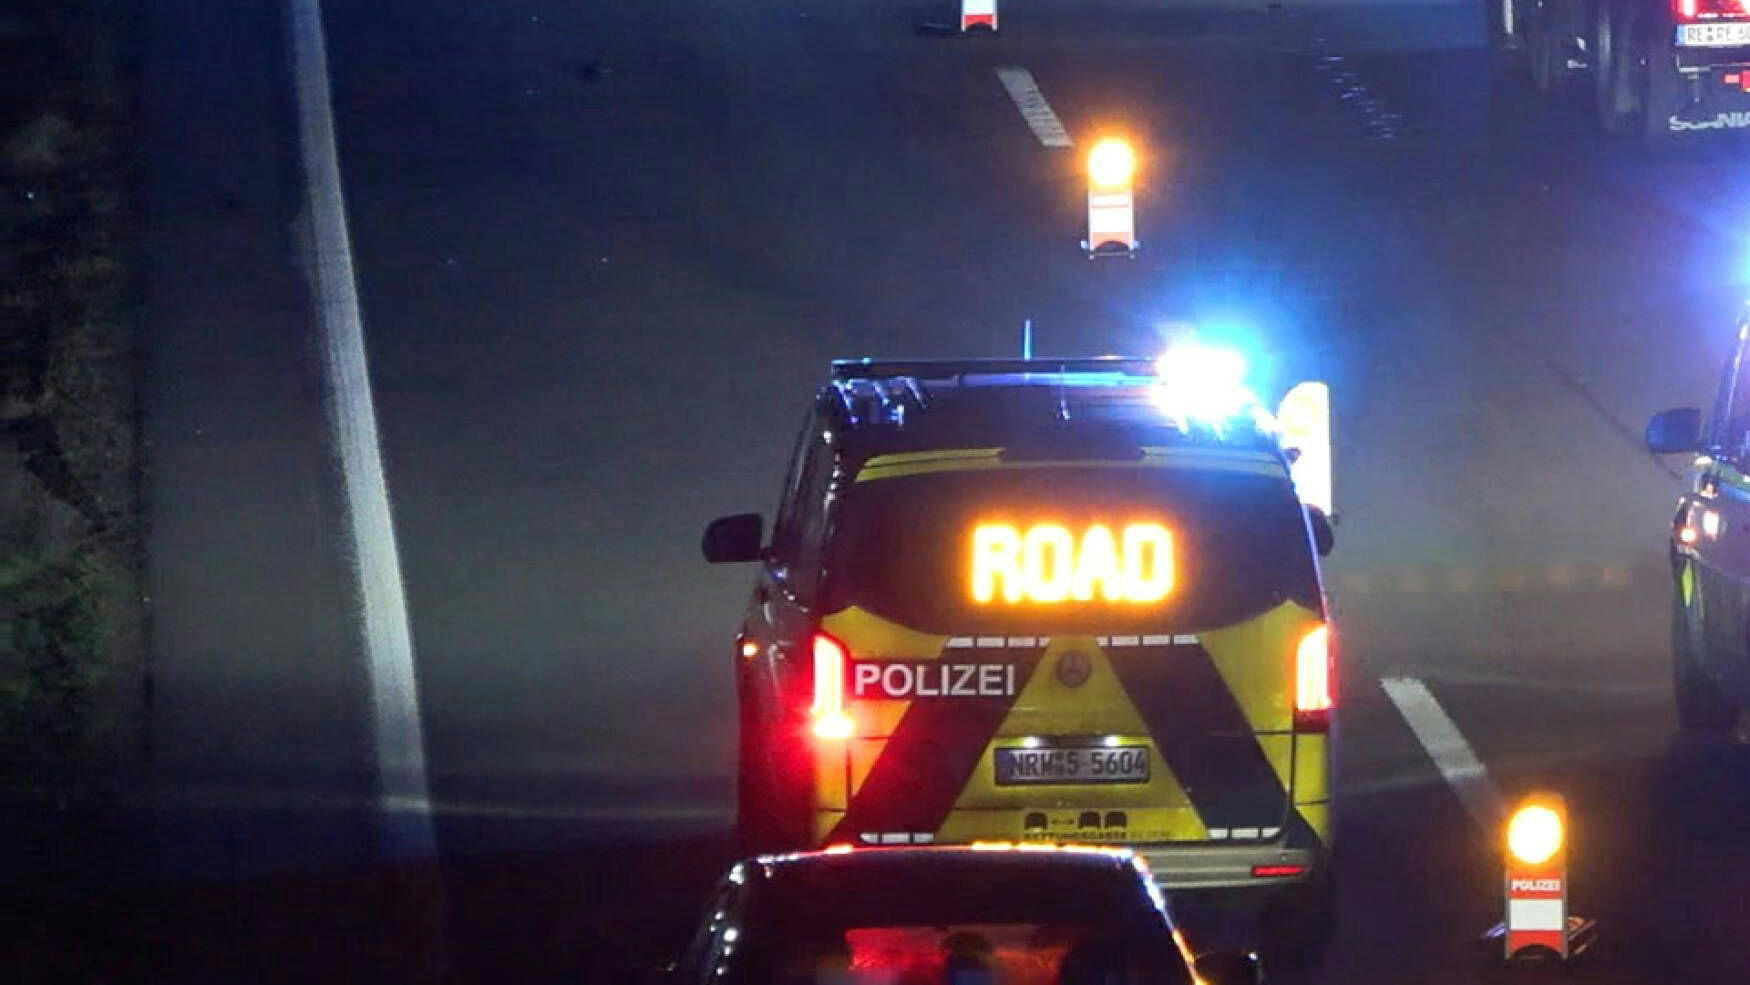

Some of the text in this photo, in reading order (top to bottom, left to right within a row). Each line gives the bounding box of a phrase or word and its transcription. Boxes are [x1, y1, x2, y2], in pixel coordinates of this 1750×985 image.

[972, 522, 1174, 604] ROAD
[855, 664, 1015, 696] POLIZEI
[1010, 752, 1053, 776] NRW
